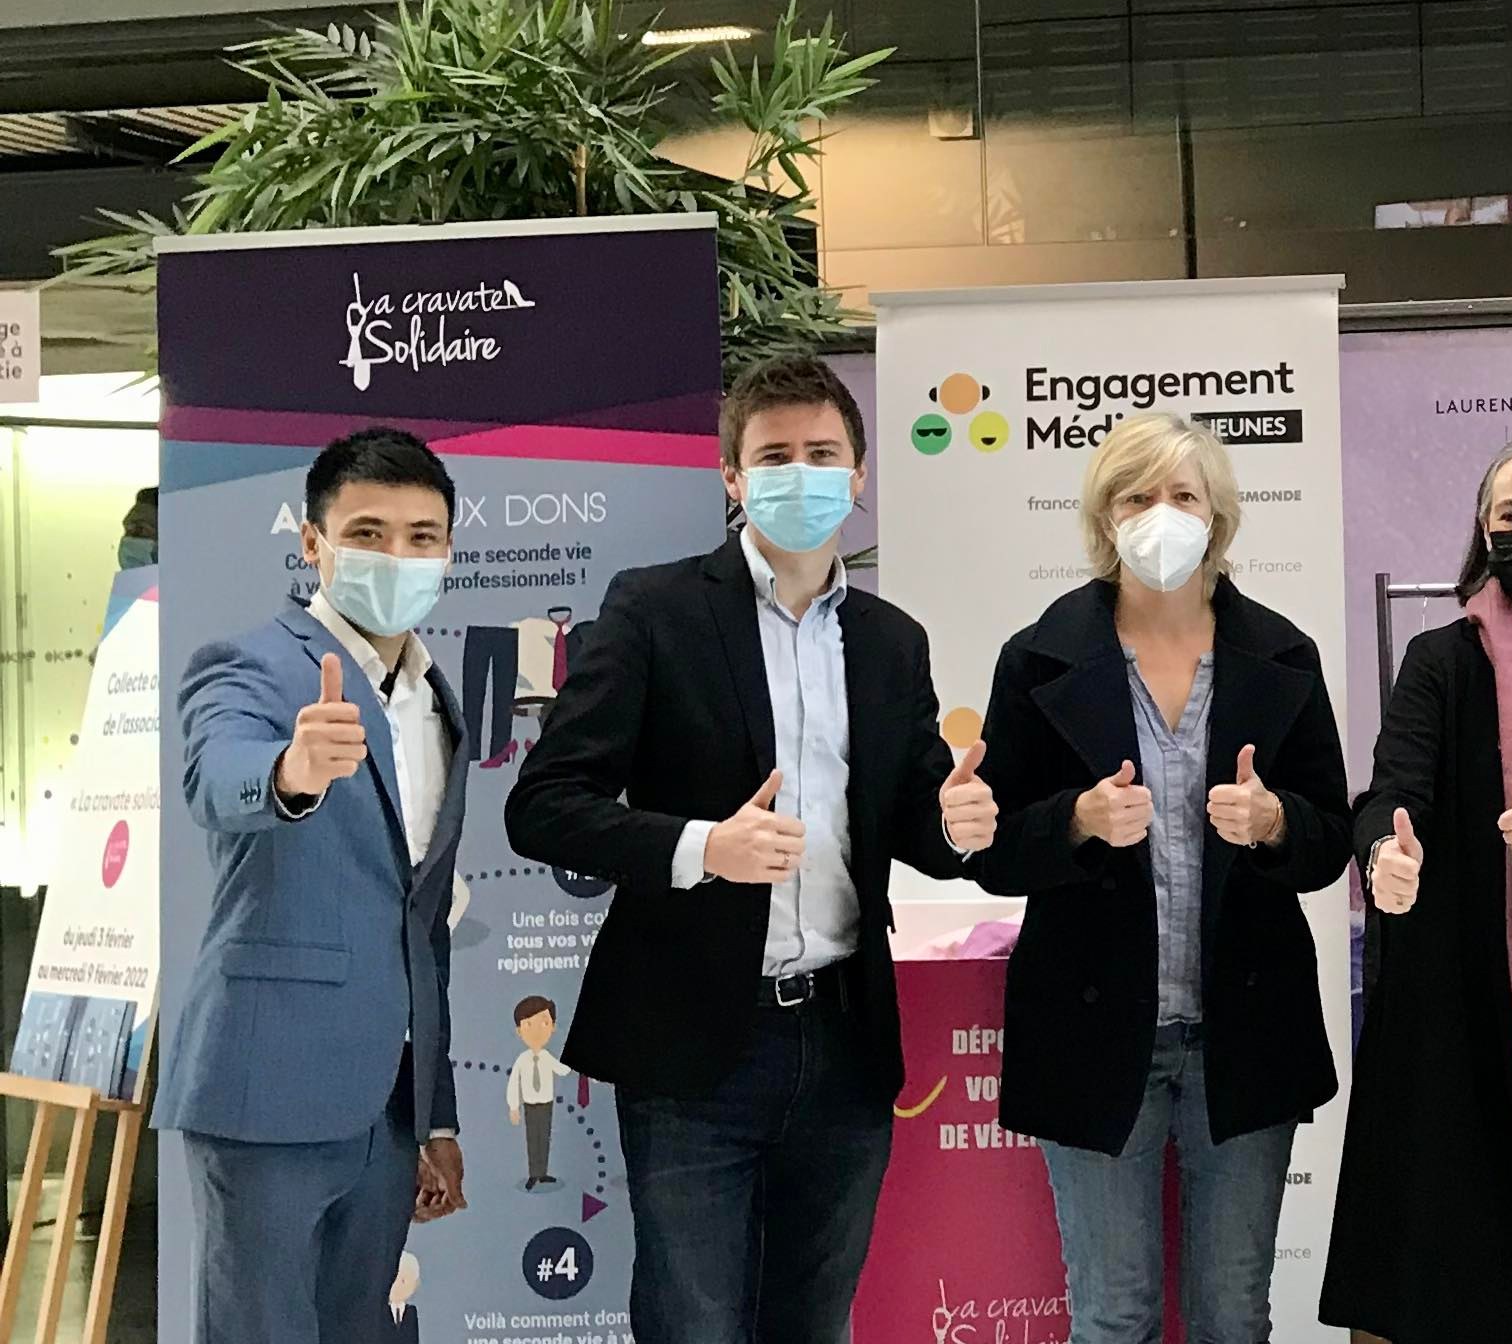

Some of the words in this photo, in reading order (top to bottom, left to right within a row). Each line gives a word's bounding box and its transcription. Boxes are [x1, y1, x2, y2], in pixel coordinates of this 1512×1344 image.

[353, 272, 396, 315] La
[402, 281, 504, 312] cravate
[364, 314, 501, 372] Solidaire
[1026, 362, 1295, 411] Engagement
[1027, 412, 1124, 449] Méd
[505, 491, 607, 526] DONS
[485, 541, 561, 564] seconde
[565, 542, 592, 560] vie
[1249, 558, 1303, 573] France
[443, 568, 578, 594] professionnels
[107, 671, 149, 695] Collecte
[103, 712, 116, 736] de
[78, 788, 92, 812] La
[92, 791, 131, 811] cravate
[512, 911, 545, 928] Une
[549, 909, 579, 926] fois
[63, 924, 73, 945] du
[73, 925, 97, 951] jeudi
[97, 926, 105, 947] 3
[105, 927, 134, 948] février
[507, 934, 543, 948] tous
[548, 935, 577, 947] vos
[37, 964, 48, 980] au
[50, 962, 87, 982] mercredi
[87, 962, 94, 984] 9
[94, 963, 123, 985] février
[123, 965, 149, 988] 2022
[498, 953, 580, 974] rejoignent
[965, 1075, 1001, 1102] VO
[940, 1124, 969, 1150] DE
[537, 1247, 579, 1282] #4
[939, 1279, 979, 1319] La
[464, 1312, 506, 1330] Voilà
[510, 1312, 590, 1329] comment
[595, 1309, 631, 1326] don
